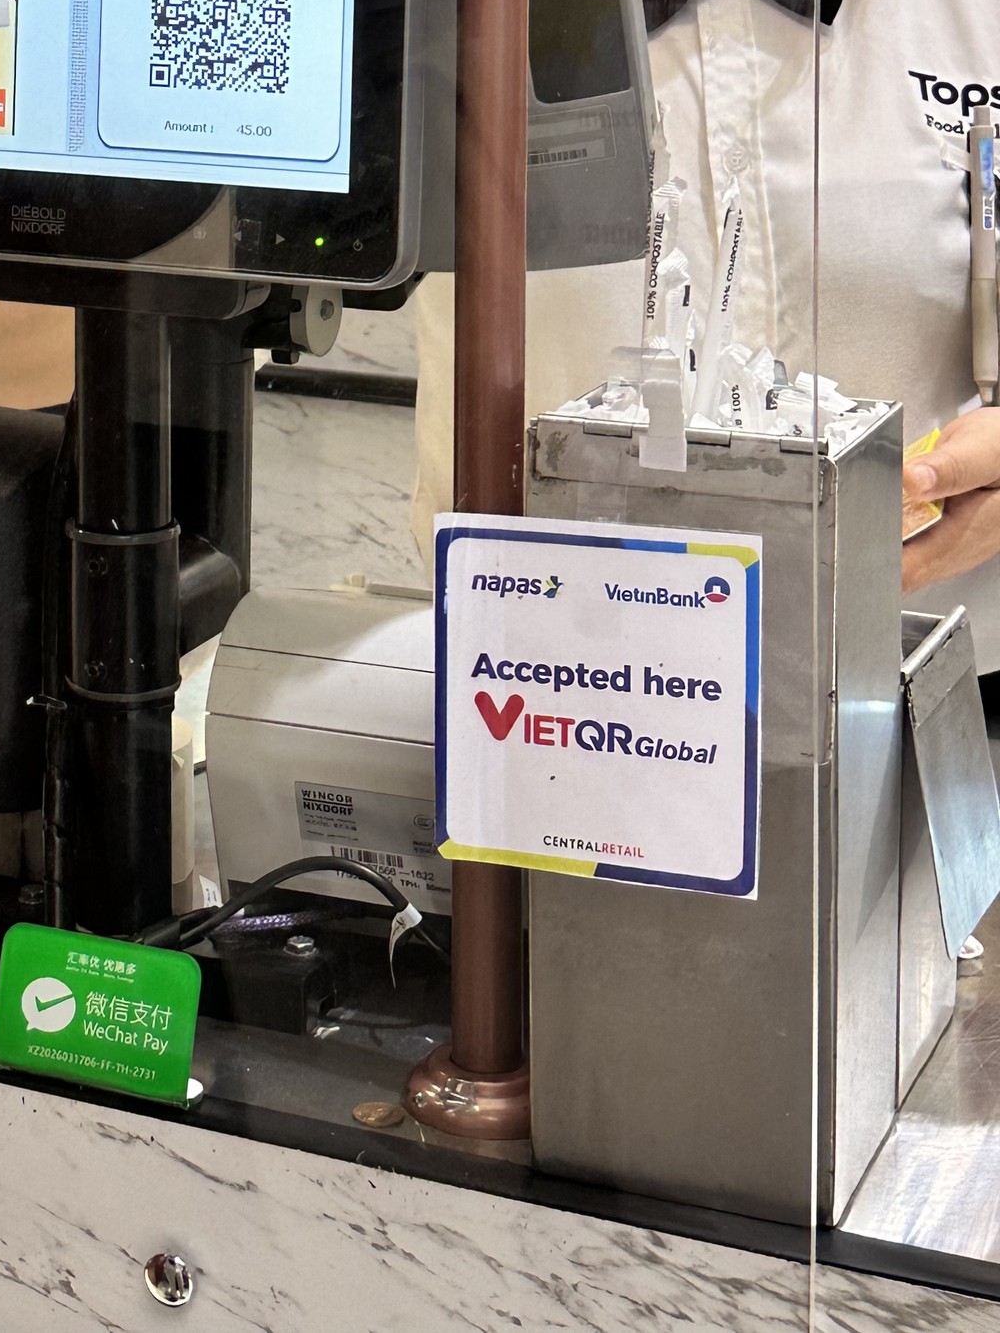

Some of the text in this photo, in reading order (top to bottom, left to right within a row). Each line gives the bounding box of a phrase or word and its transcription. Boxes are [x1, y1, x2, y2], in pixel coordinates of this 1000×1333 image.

[164, 121, 272, 137] Amount 45.00
[924, 114, 964, 134] Food
[11, 221, 65, 235] NIXDORF
[646, 290, 657, 320] 100%
[731, 384, 742, 412] 100%
[472, 574, 542, 598] napas
[471, 653, 722, 701] Accepted here
[636, 736, 717, 764] Global
[302, 789, 352, 804] WINCOR
[303, 802, 353, 816] NIXDORF
[543, 835, 644, 859] CENTRALRETAIL
[85, 991, 172, 1030] 微信支付
[83, 1020, 168, 1055] WeChat Pay
